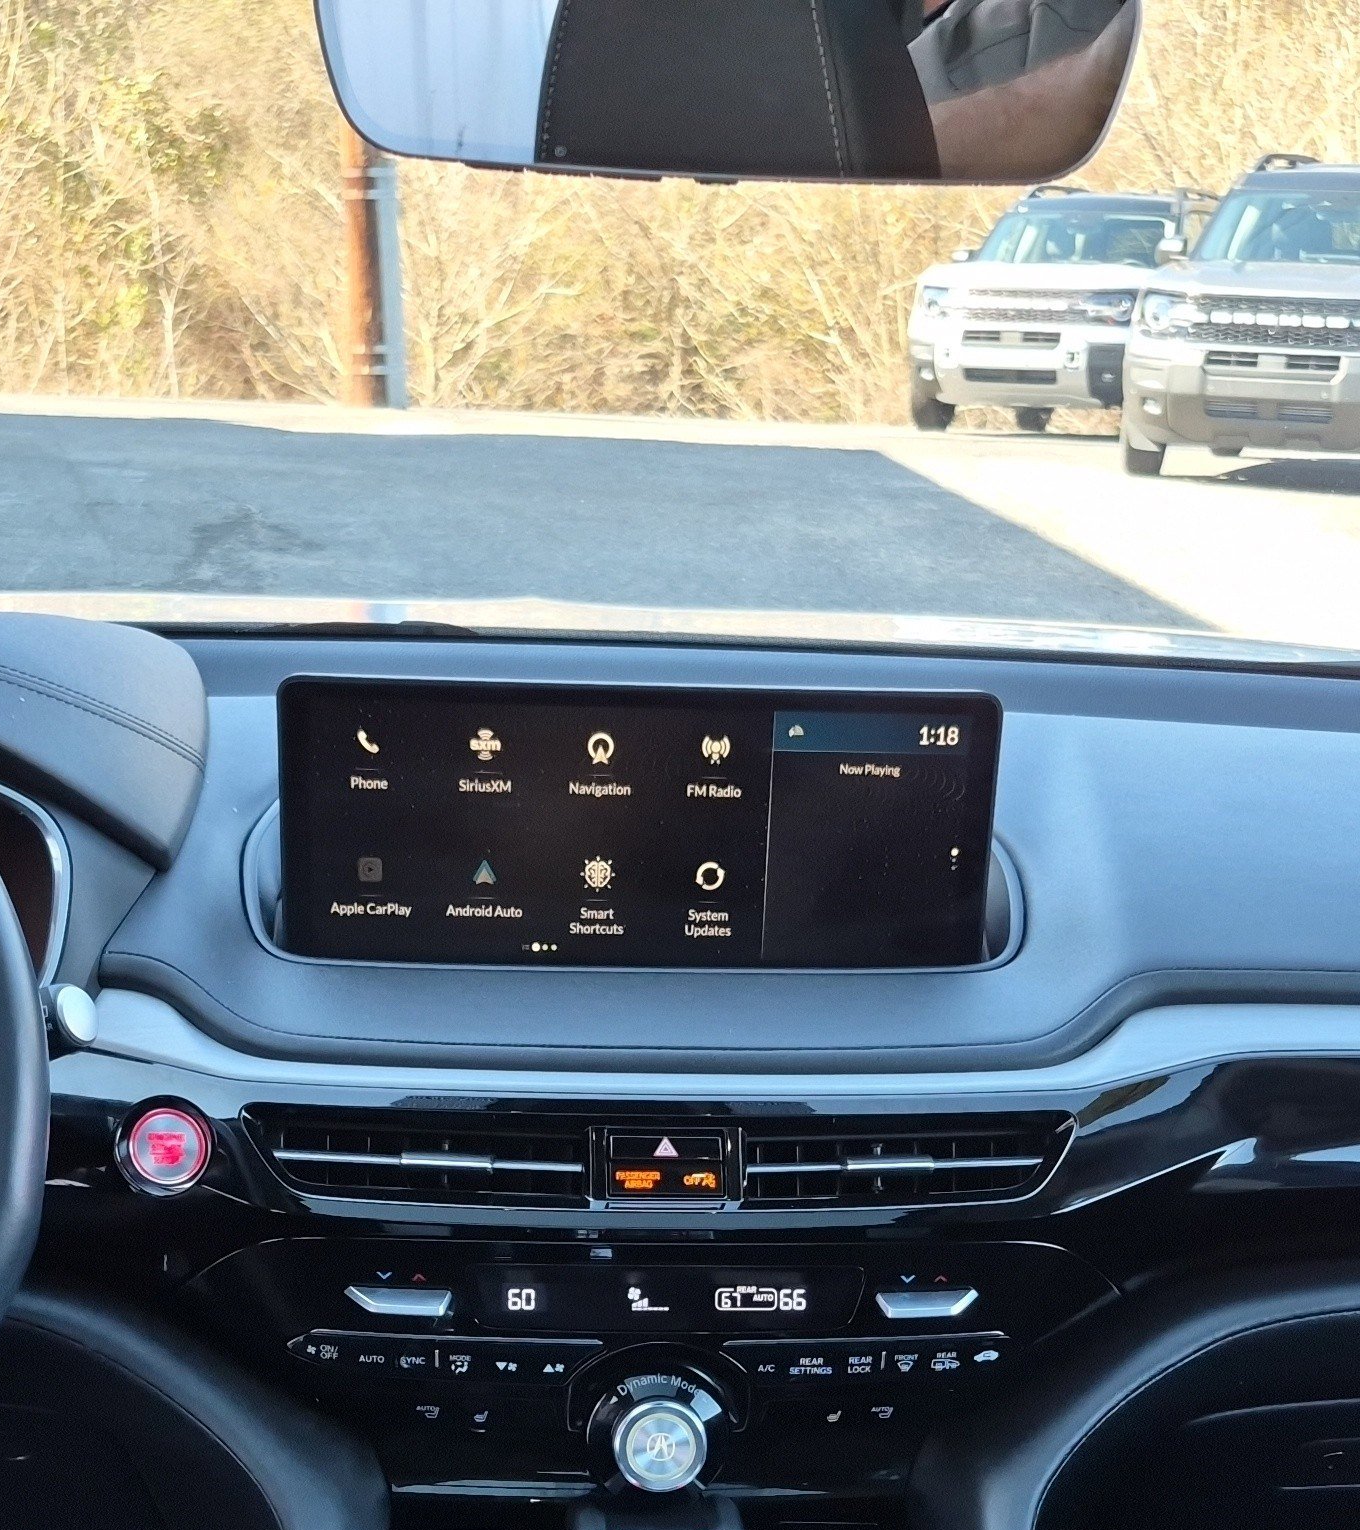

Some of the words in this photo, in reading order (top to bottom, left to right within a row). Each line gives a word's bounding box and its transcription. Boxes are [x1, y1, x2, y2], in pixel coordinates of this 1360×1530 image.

[919, 725, 960, 746] 1:18
[839, 763, 864, 775] Now
[865, 763, 901, 778] Playing
[350, 775, 389, 790] Phone
[458, 778, 512, 793] SiriusXM
[568, 781, 632, 797] Navigation
[686, 784, 707, 798] FM
[708, 784, 742, 798] Radio
[330, 901, 365, 916] Apple
[366, 902, 412, 917] CarPlay
[445, 904, 493, 917] Android
[494, 905, 523, 918] Auto
[580, 907, 614, 920] Smart
[687, 909, 729, 923] System
[569, 922, 625, 935] Shortcuts
[684, 924, 732, 938] Updates
[507, 1288, 536, 1311] 60
[779, 1288, 807, 1311] 66
[319, 1351, 339, 1360] OFF
[358, 1354, 385, 1363] AUTO
[400, 1355, 426, 1365] SYNC
[449, 1354, 472, 1362] MODE
[799, 1357, 824, 1366] REAR
[848, 1356, 873, 1364] REAR
[757, 1364, 776, 1373] A/C
[789, 1366, 833, 1375] SETTINGS
[847, 1365, 871, 1374] LOCK
[616, 1373, 668, 1397] Dynamic
[670, 1374, 701, 1396] Mode
